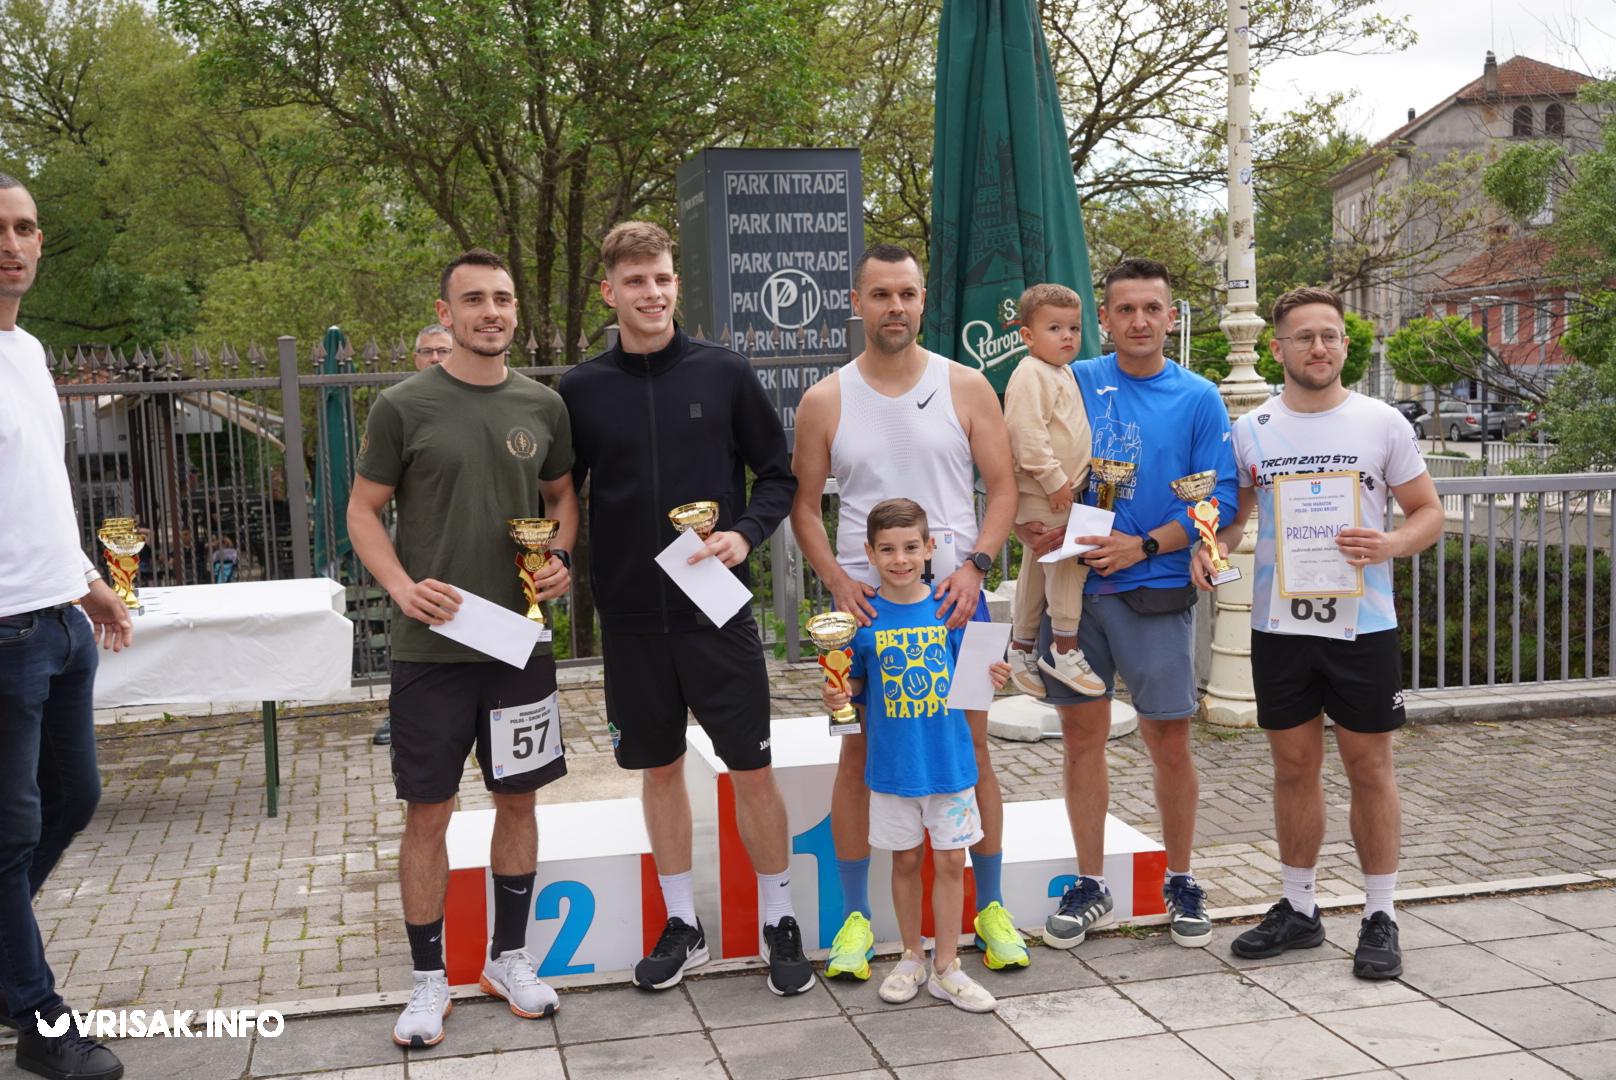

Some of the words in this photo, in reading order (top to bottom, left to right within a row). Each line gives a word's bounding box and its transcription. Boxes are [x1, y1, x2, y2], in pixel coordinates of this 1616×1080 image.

[727, 174, 770, 195] PARK
[729, 213, 772, 235] PARK
[731, 252, 773, 274] PARK
[1298, 455, 1331, 465] ZATO
[1290, 596, 1337, 623] 63
[875, 625, 949, 648] BETTER
[882, 699, 949, 719] HAPPY
[512, 718, 550, 760] 57
[535, 880, 596, 978] 2
